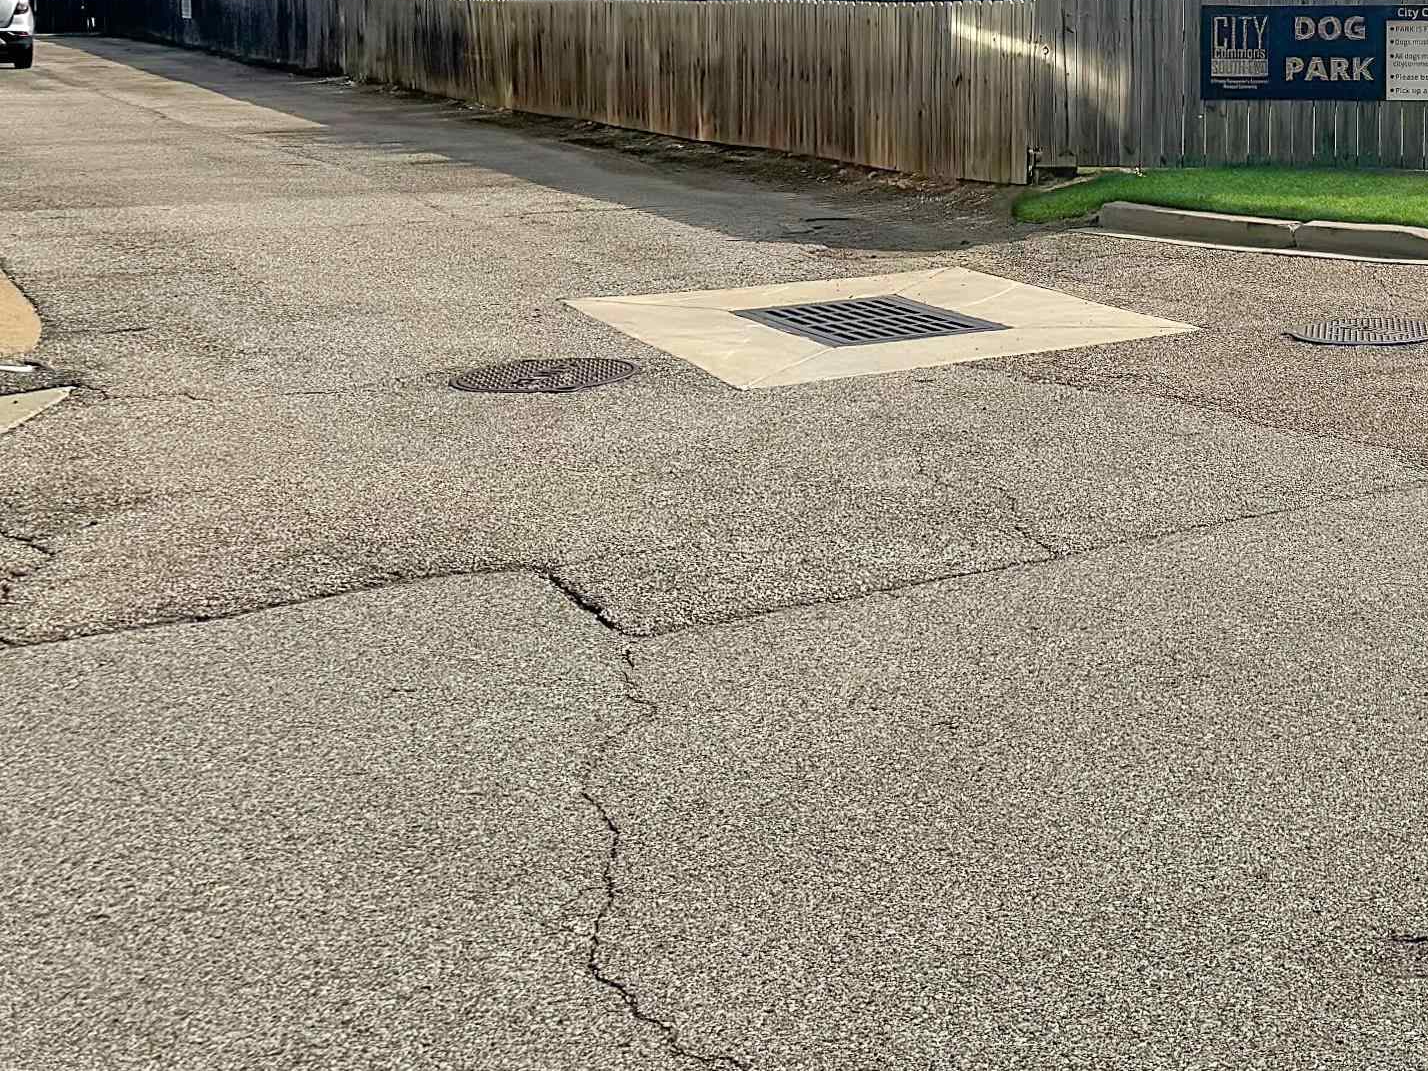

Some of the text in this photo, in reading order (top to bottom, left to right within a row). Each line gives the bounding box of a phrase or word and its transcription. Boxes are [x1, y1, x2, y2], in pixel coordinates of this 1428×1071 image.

[1397, 7, 1419, 20] City
[1213, 16, 1268, 49] CITY
[1294, 16, 1366, 41] DOG
[1213, 48, 1266, 59] commons
[1286, 56, 1376, 81] PARK
